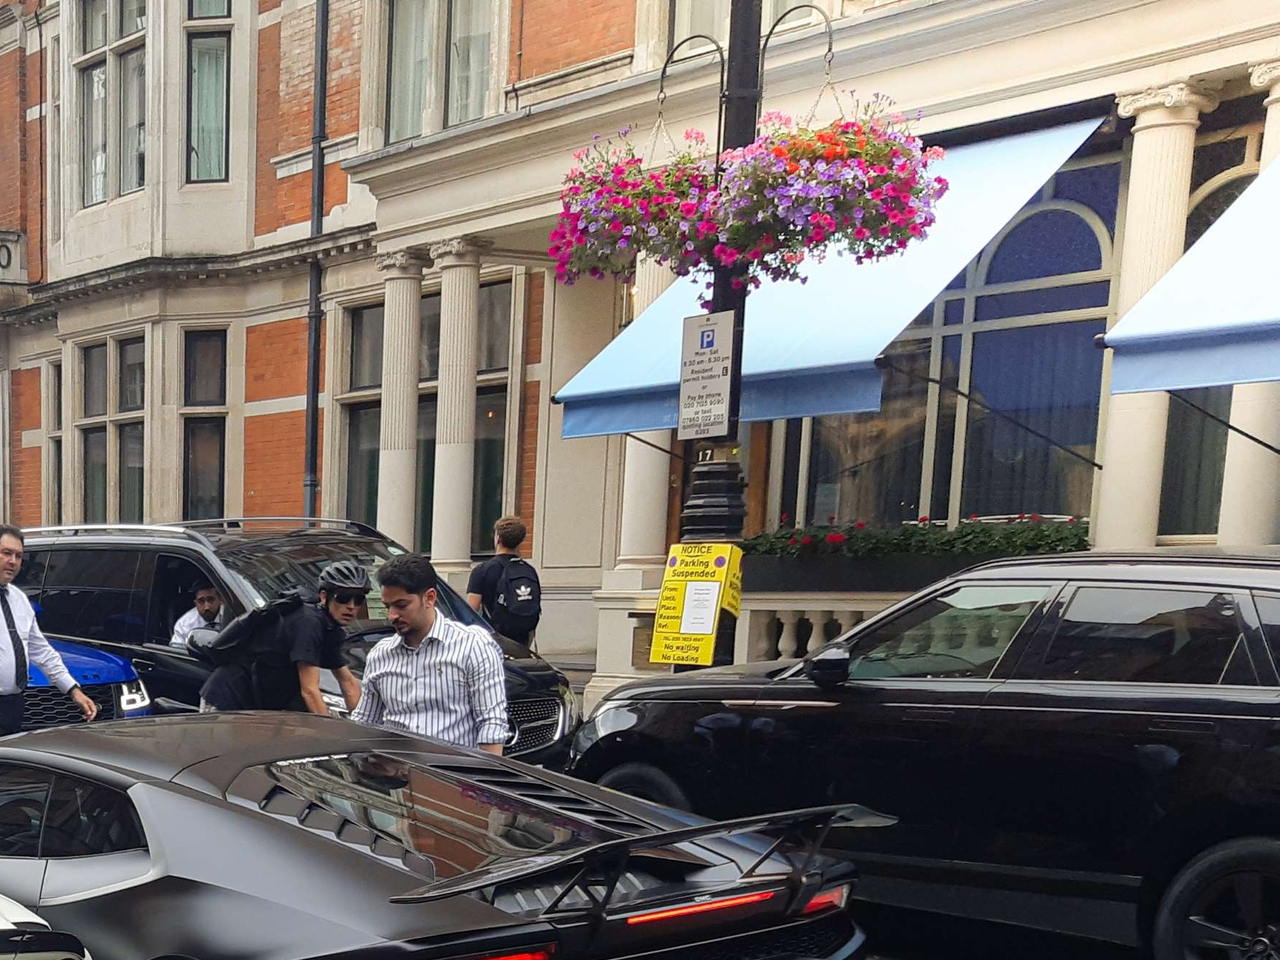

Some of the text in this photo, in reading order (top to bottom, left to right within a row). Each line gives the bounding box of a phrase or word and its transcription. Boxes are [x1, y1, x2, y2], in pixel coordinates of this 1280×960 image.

[703, 331, 714, 348] P
[698, 450, 712, 461] 17
[681, 546, 713, 554] NOTICE
[679, 559, 710, 568] Parking
[671, 569, 717, 578] Suspended
[675, 644, 700, 652] waiting
[672, 654, 699, 663] Loading
